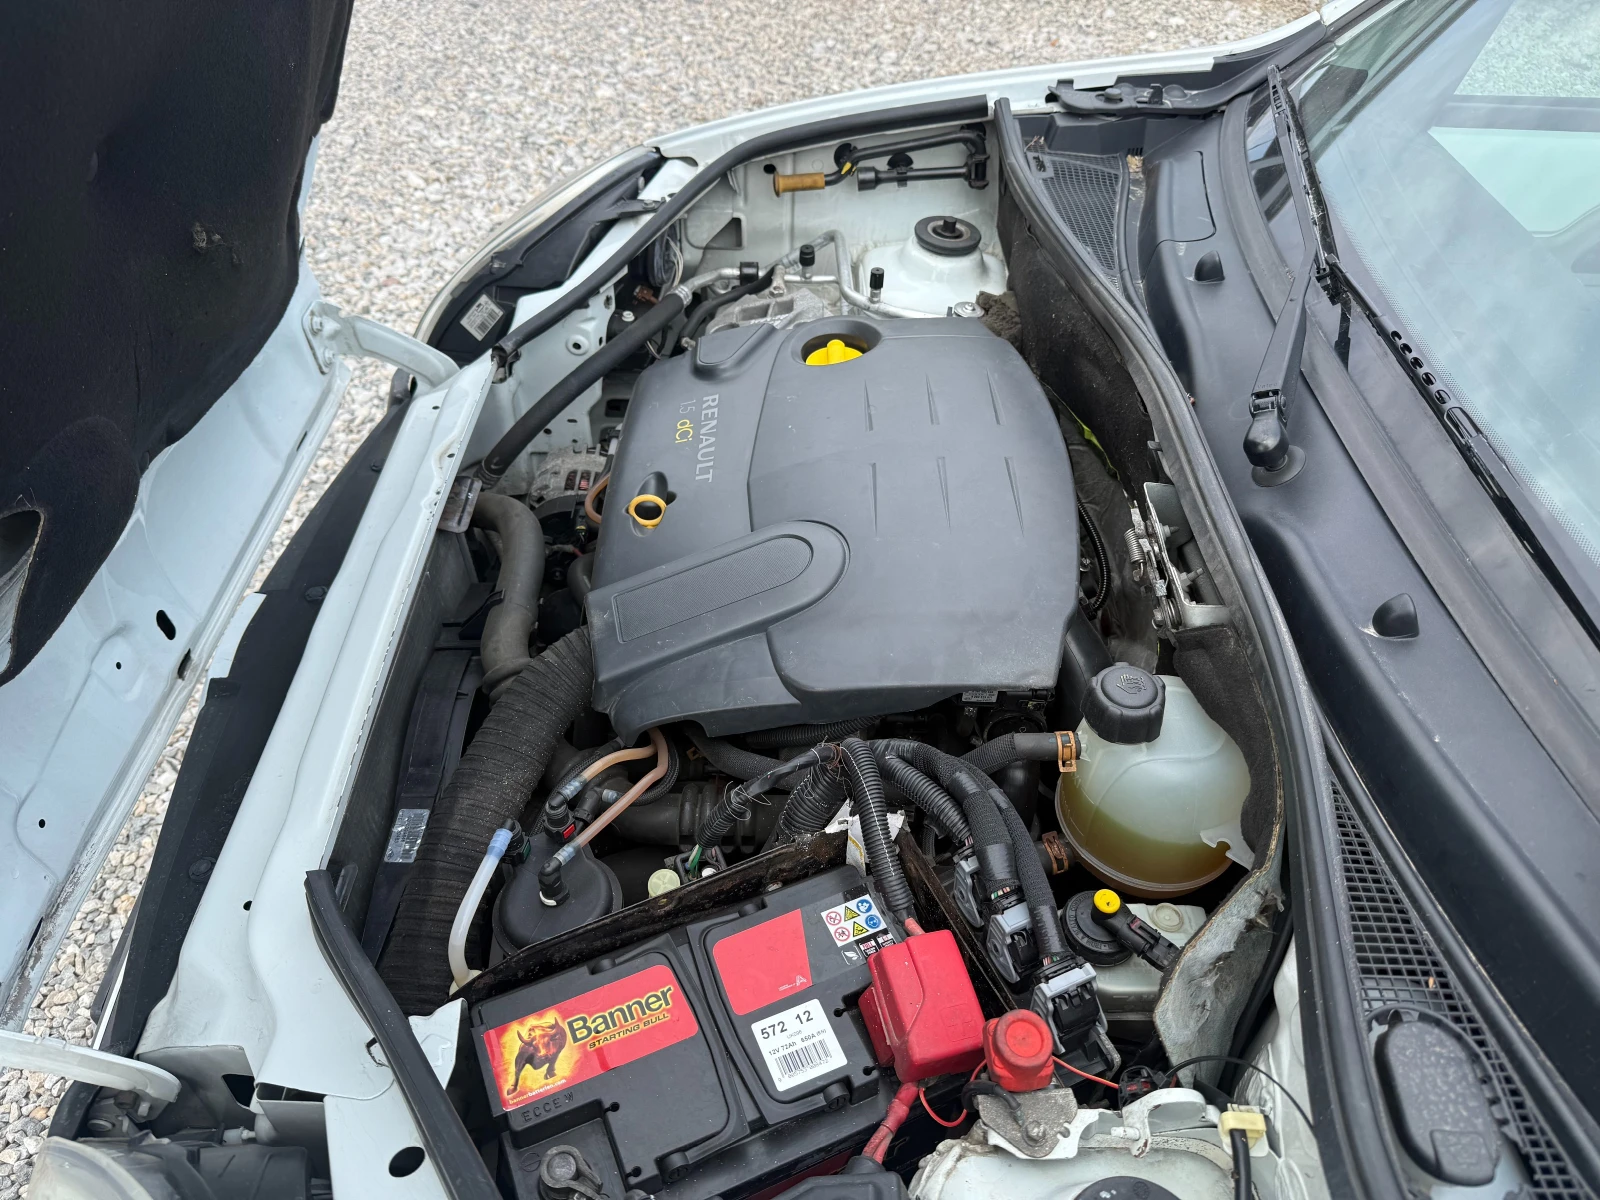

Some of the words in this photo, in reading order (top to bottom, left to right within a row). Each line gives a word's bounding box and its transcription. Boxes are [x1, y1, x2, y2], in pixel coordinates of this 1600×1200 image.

[679, 399, 696, 414] 1.5
[675, 419, 694, 444] dCi
[695, 393, 719, 483] RENAULT
[566, 986, 673, 1044] Banner
[760, 1020, 788, 1040] 572
[795, 1010, 814, 1025] 12
[589, 1024, 641, 1049] STARTING
[643, 1013, 669, 1028] BULL
[768, 1046, 780, 1056] 12V
[780, 1041, 797, 1051] 72Ah
[508, 1078, 567, 1105] bannerbatterien.com
